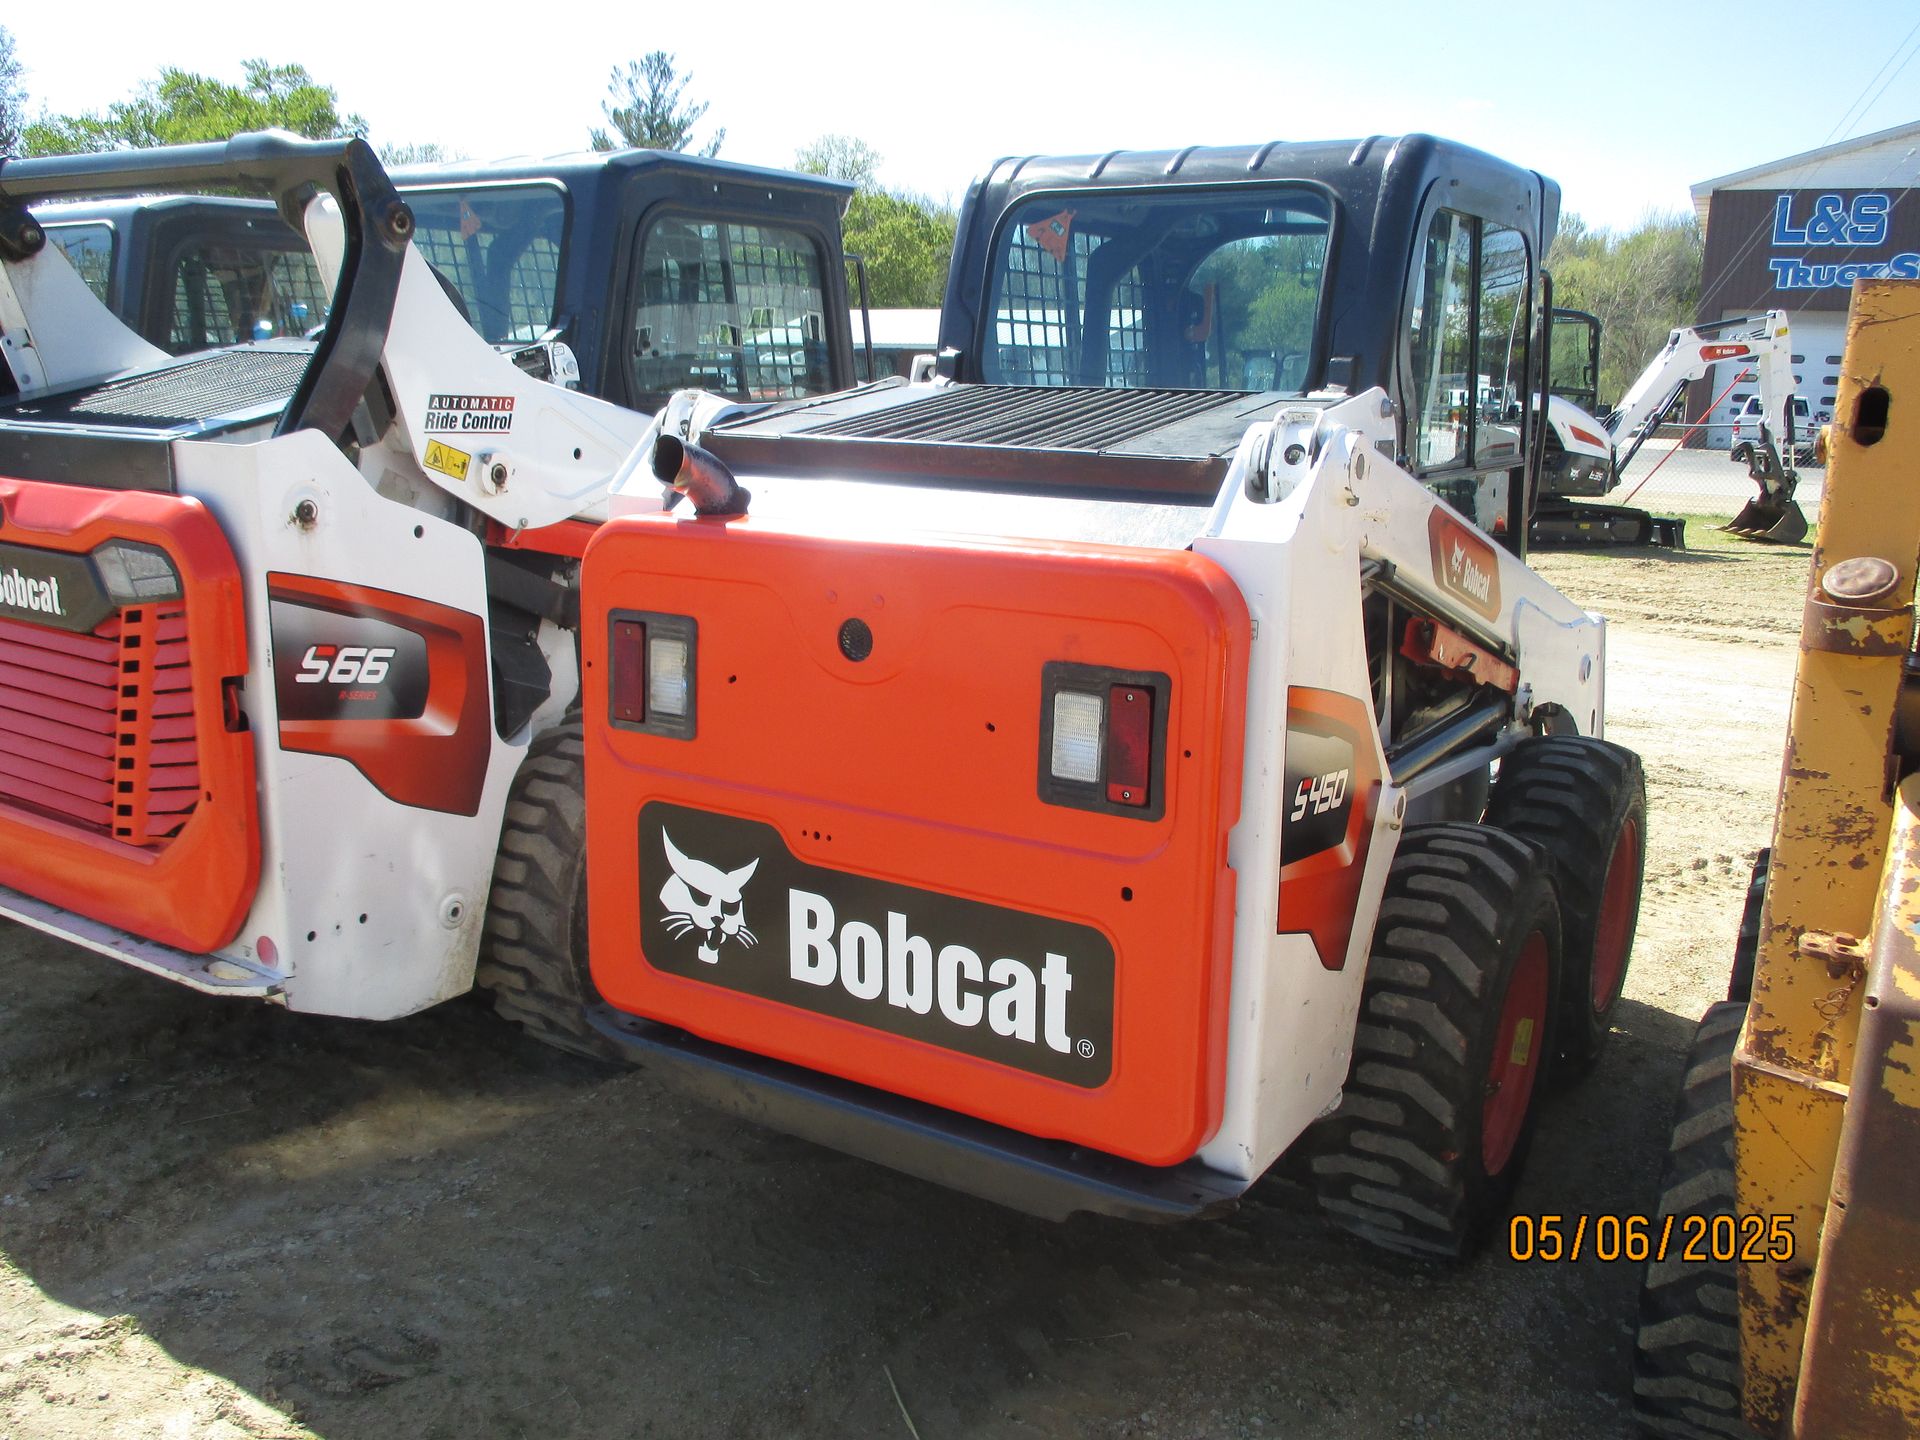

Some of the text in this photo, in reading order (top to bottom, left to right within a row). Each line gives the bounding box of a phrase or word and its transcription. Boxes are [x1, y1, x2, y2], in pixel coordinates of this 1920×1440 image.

[1772, 194, 1890, 246] L&S
[424, 411, 513, 430] Ride Control
[431, 397, 512, 410] AUTOMATIC
[1463, 556, 1491, 603] Bobcat
[295, 646, 396, 684] S66
[338, 690, 378, 701] R-SERIES
[1290, 769, 1349, 822] S450
[788, 887, 1073, 1054] Bobcat
